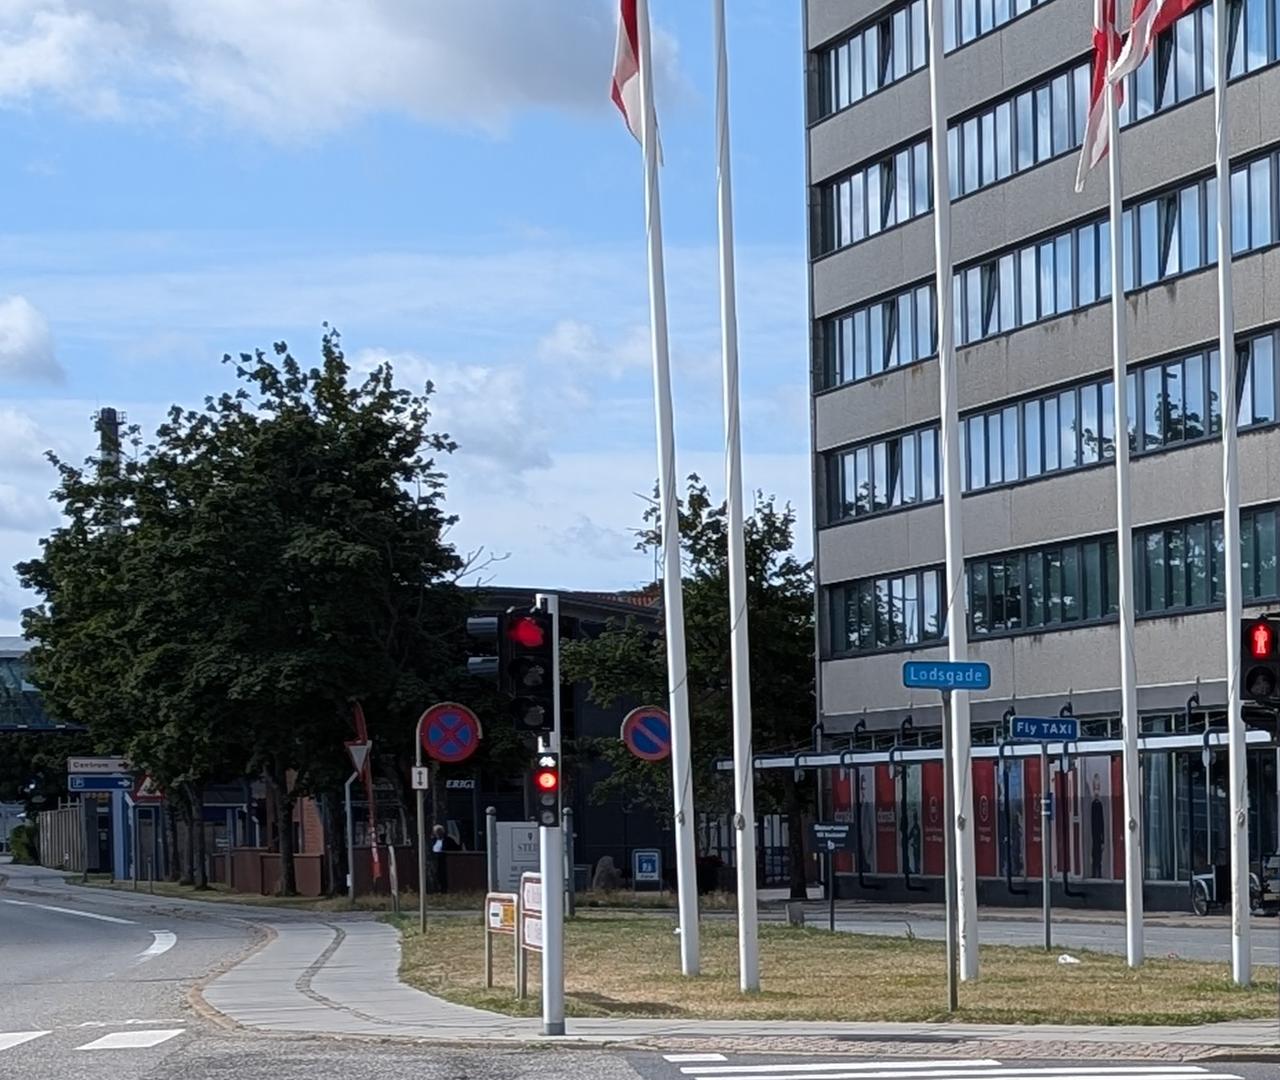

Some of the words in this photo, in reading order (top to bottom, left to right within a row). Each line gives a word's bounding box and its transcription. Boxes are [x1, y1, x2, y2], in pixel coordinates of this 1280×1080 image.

[910, 666, 983, 685] Lodsgade
[1016, 721, 1037, 736] Fly
[1042, 722, 1073, 735] TAXI
